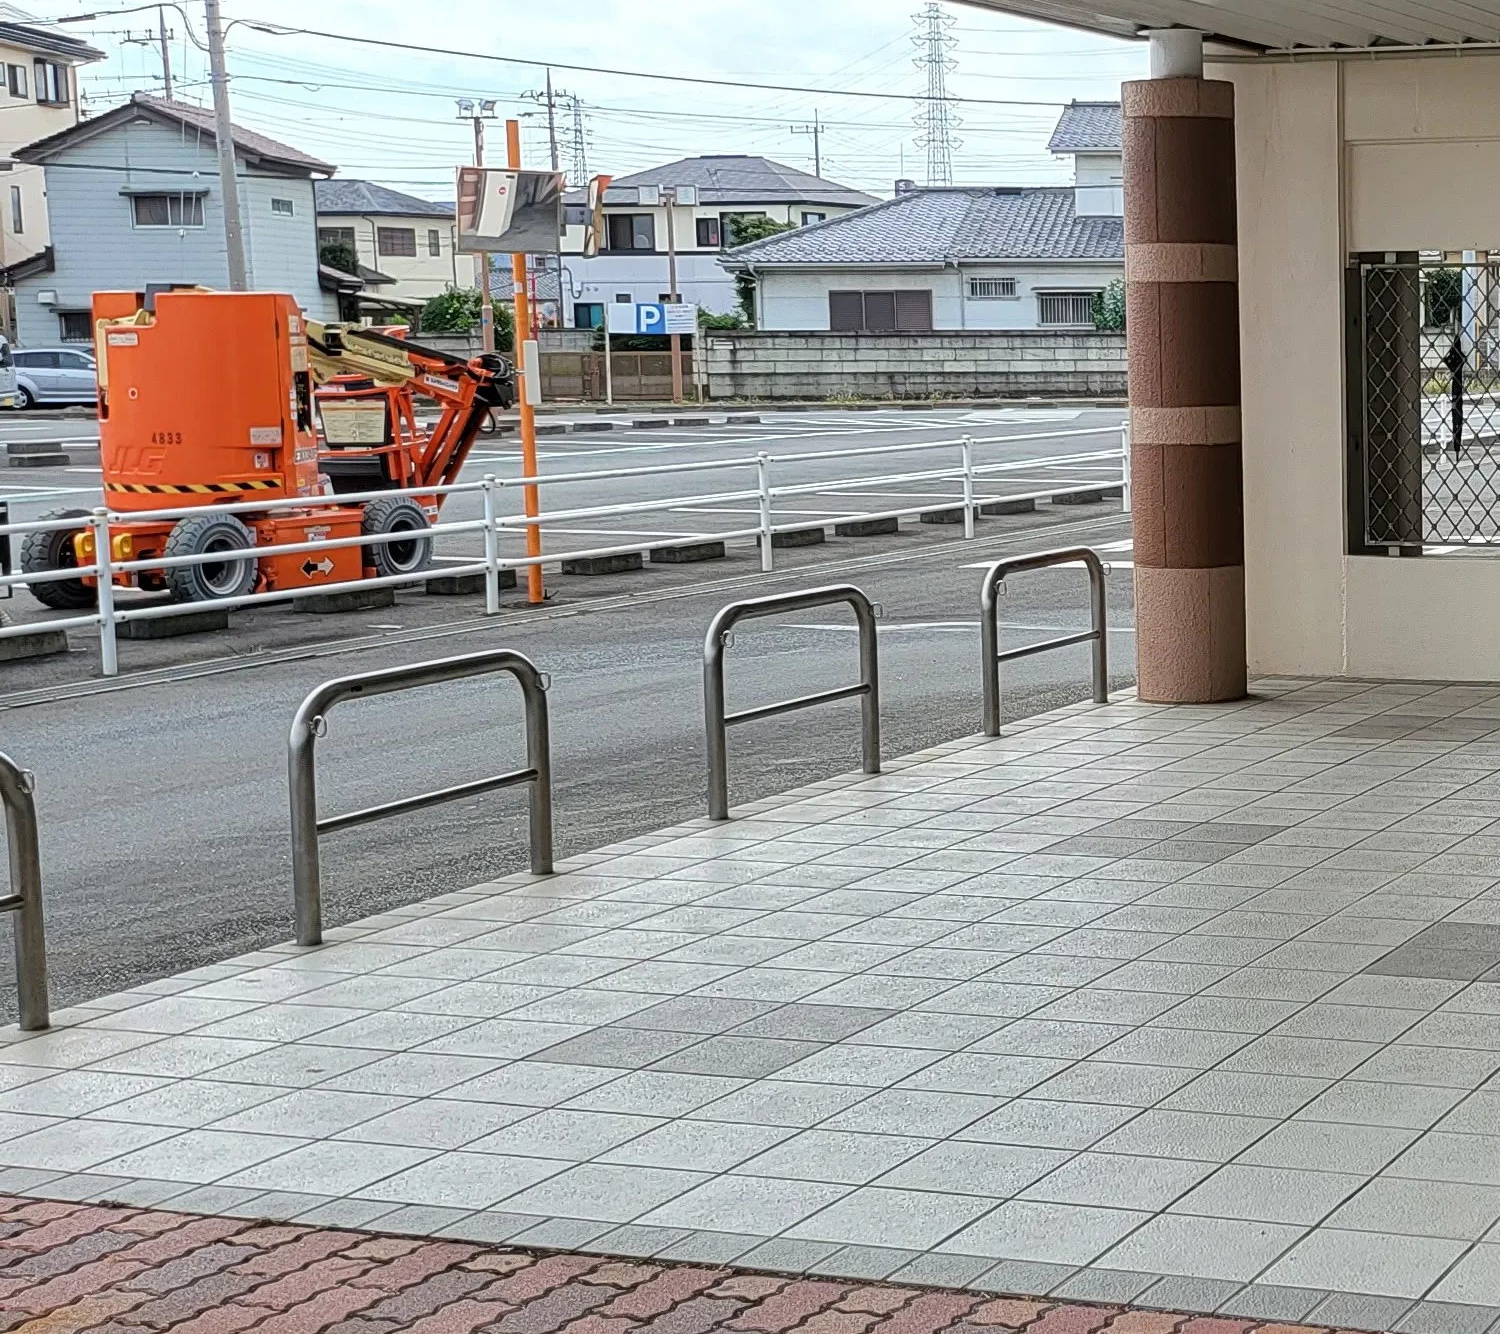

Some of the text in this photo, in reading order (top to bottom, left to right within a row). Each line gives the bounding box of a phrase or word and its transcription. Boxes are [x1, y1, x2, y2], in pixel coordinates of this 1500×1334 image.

[640, 305, 660, 333] P
[151, 431, 182, 445] 4833
[109, 445, 167, 475] JLG
